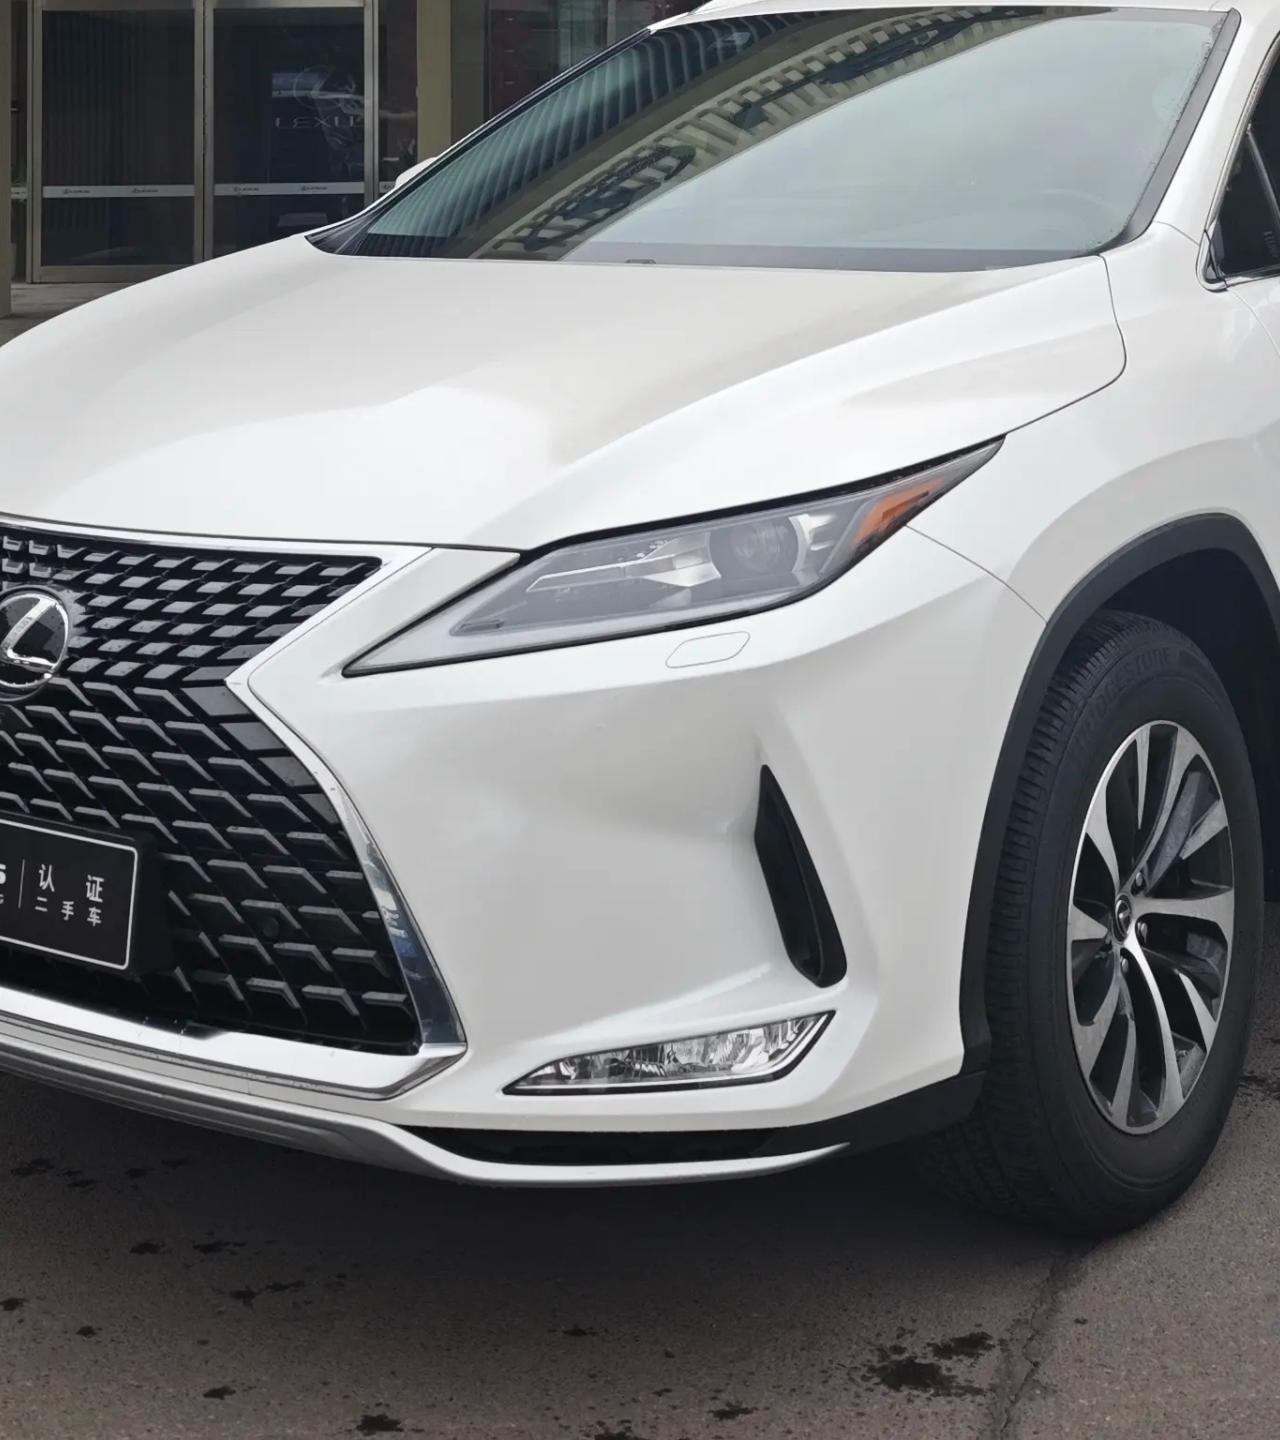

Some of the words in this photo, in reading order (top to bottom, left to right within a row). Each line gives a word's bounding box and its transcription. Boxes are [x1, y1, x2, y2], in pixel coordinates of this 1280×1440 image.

[38, 863, 105, 903] 认证
[35, 896, 102, 927] 二手车
